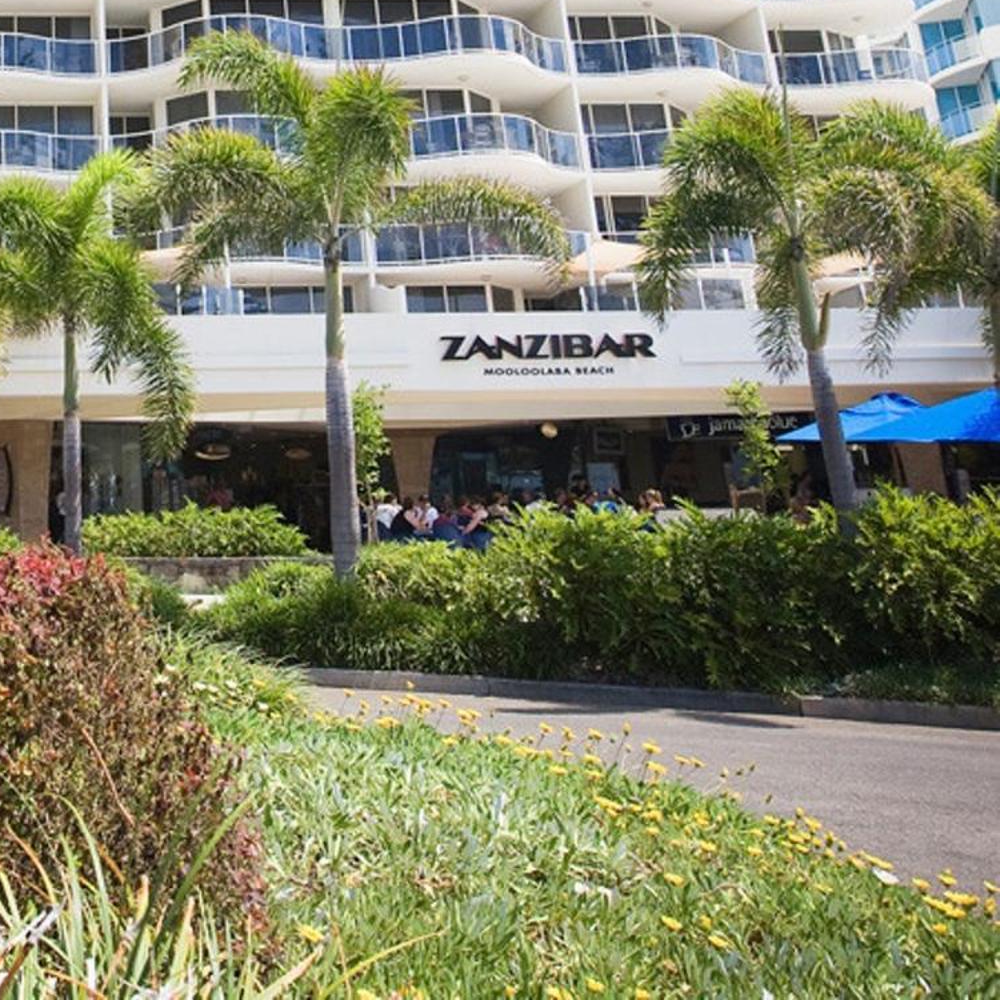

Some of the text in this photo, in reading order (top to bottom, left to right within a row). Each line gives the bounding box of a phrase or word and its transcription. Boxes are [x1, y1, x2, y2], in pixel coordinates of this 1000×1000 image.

[439, 333, 656, 361] ZANZIBAR
[483, 366, 614, 376] MOOLOOLABA BEACH
